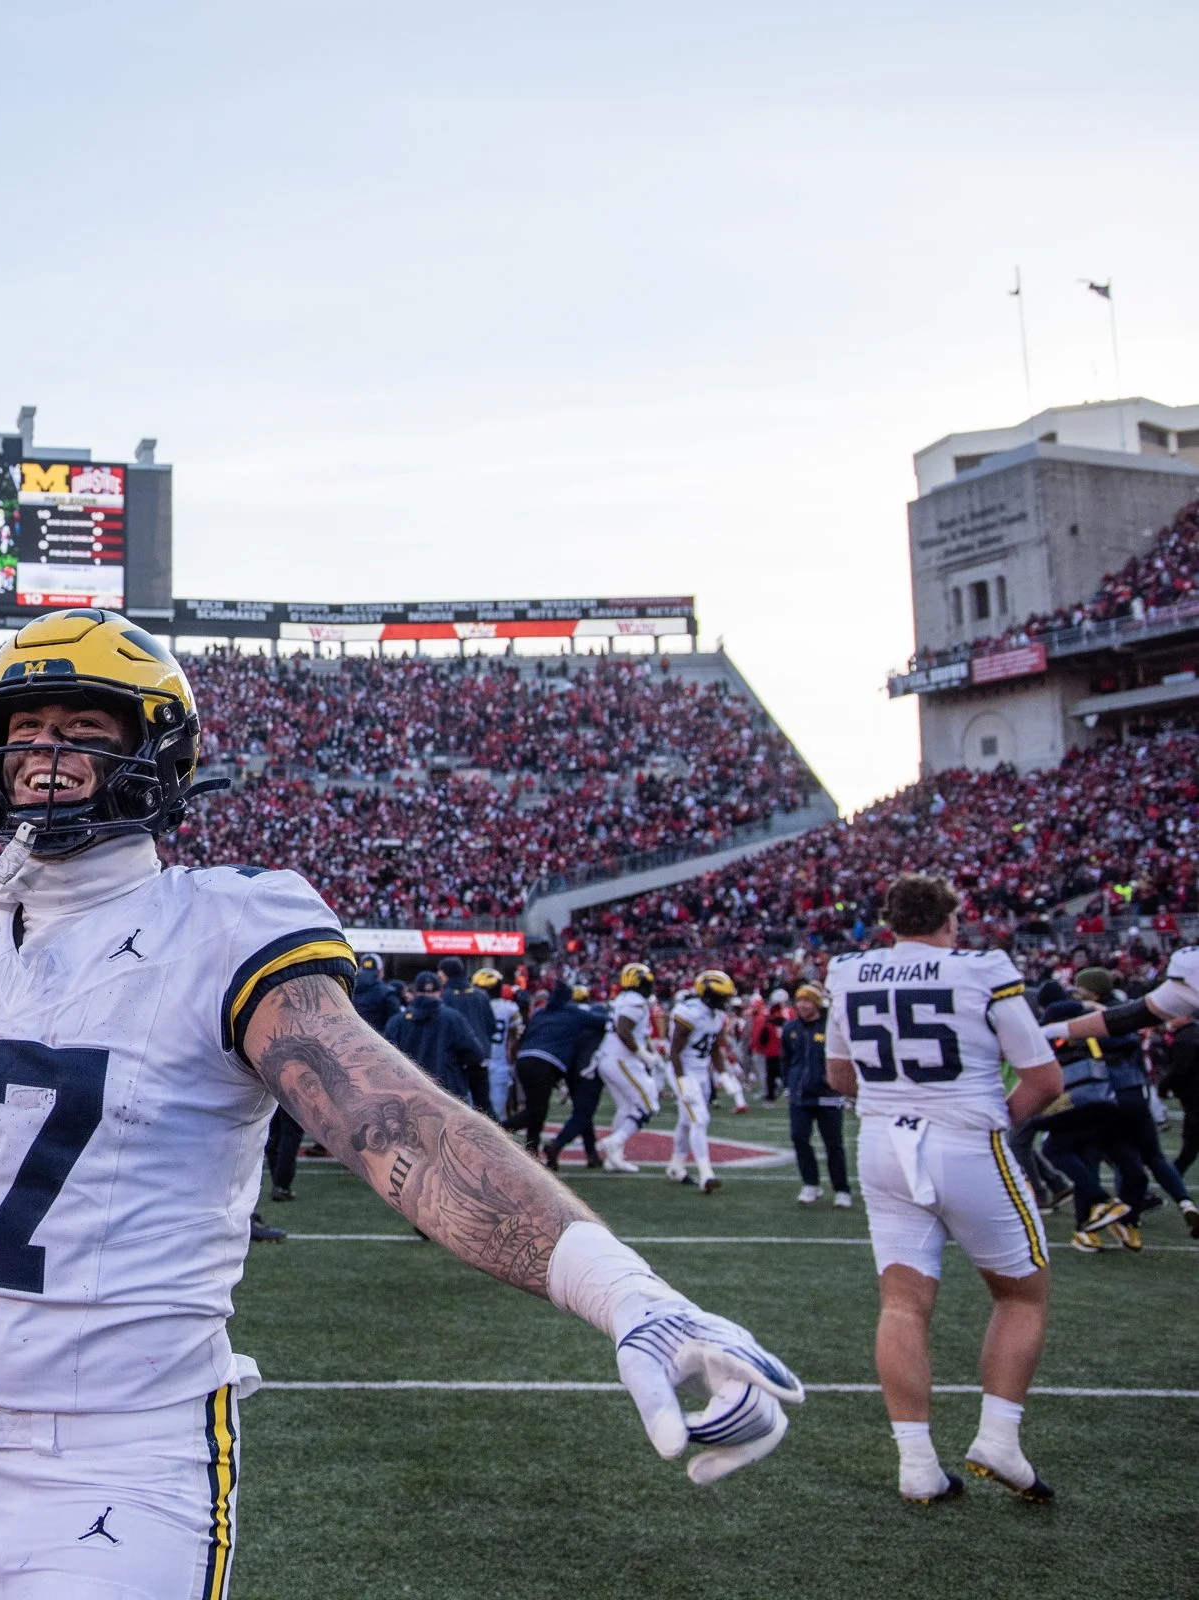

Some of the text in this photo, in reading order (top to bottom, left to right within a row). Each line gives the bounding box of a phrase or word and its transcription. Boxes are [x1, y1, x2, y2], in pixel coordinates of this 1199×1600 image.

[21, 463, 69, 492] M
[24, 593, 43, 605] 10
[23, 660, 47, 676] M
[858, 961, 940, 983] GRAHAM
[846, 988, 963, 1083] 55
[895, 1115, 922, 1131] M
